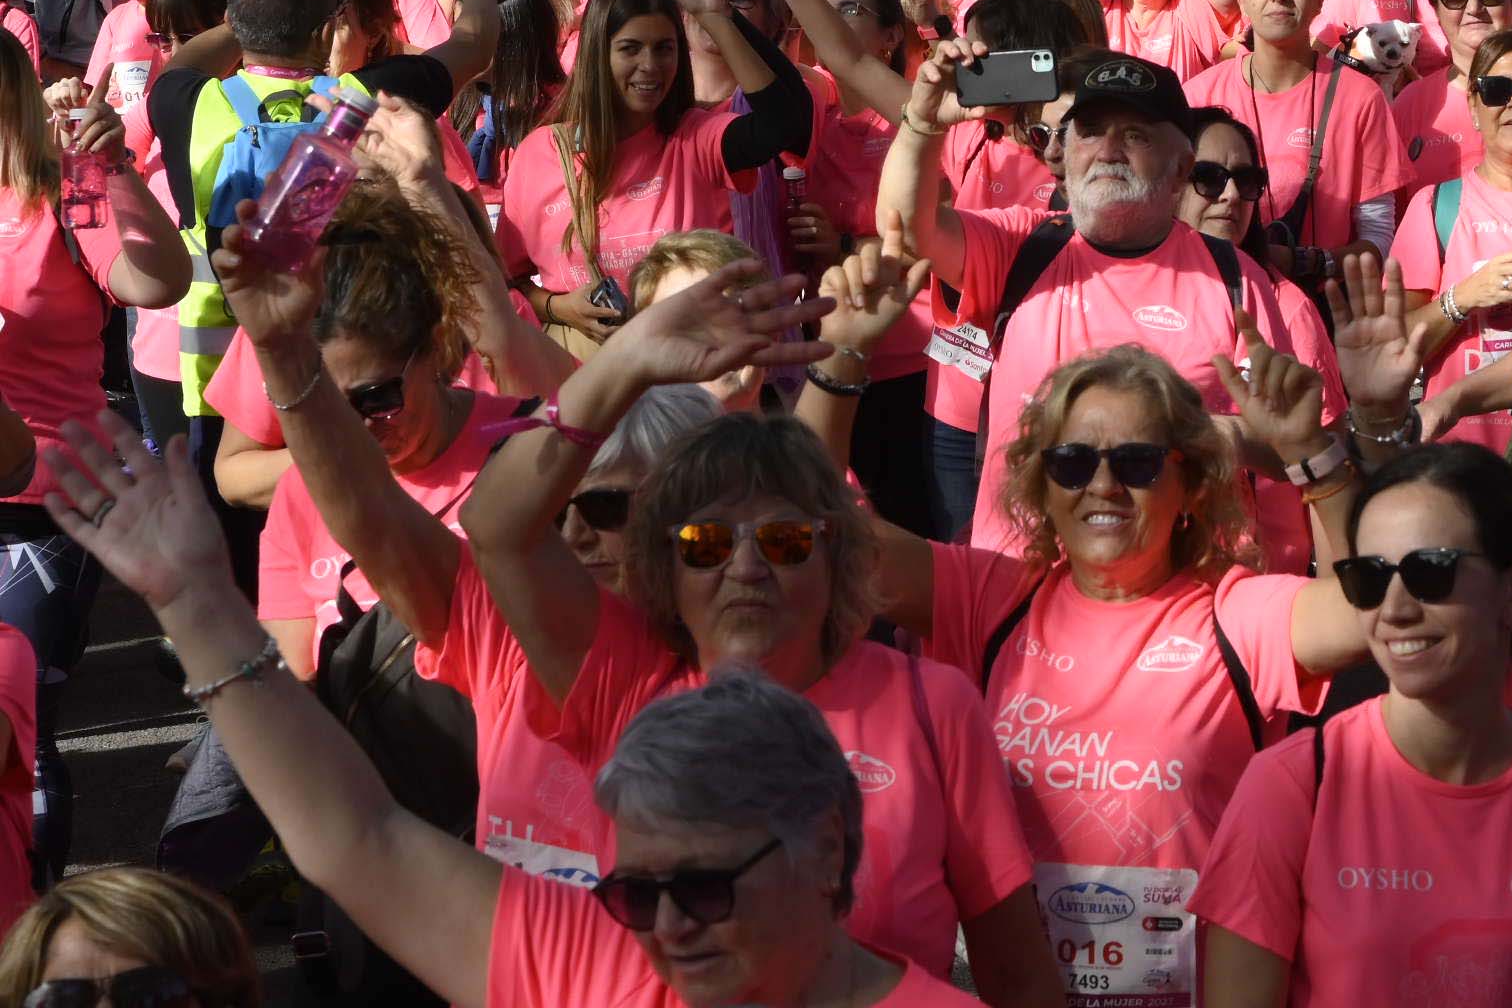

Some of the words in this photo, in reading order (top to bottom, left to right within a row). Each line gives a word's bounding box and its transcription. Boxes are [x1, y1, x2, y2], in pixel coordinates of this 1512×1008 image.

[1137, 312, 1185, 328] ASTURIANA
[1016, 635, 1075, 673] SHO
[999, 692, 1073, 726] HOY
[993, 721, 1114, 758] GANAN
[1044, 759, 1185, 792] CHICAS
[1338, 865, 1433, 892] OYSHO
[1055, 896, 1128, 915] ASTURIANA
[1143, 893, 1182, 904] SUMA
[1057, 938, 1124, 966] 016
[1067, 973, 1111, 990] 7493
[1086, 997, 1100, 1007] LA
[1103, 997, 1143, 1007] MUJER
